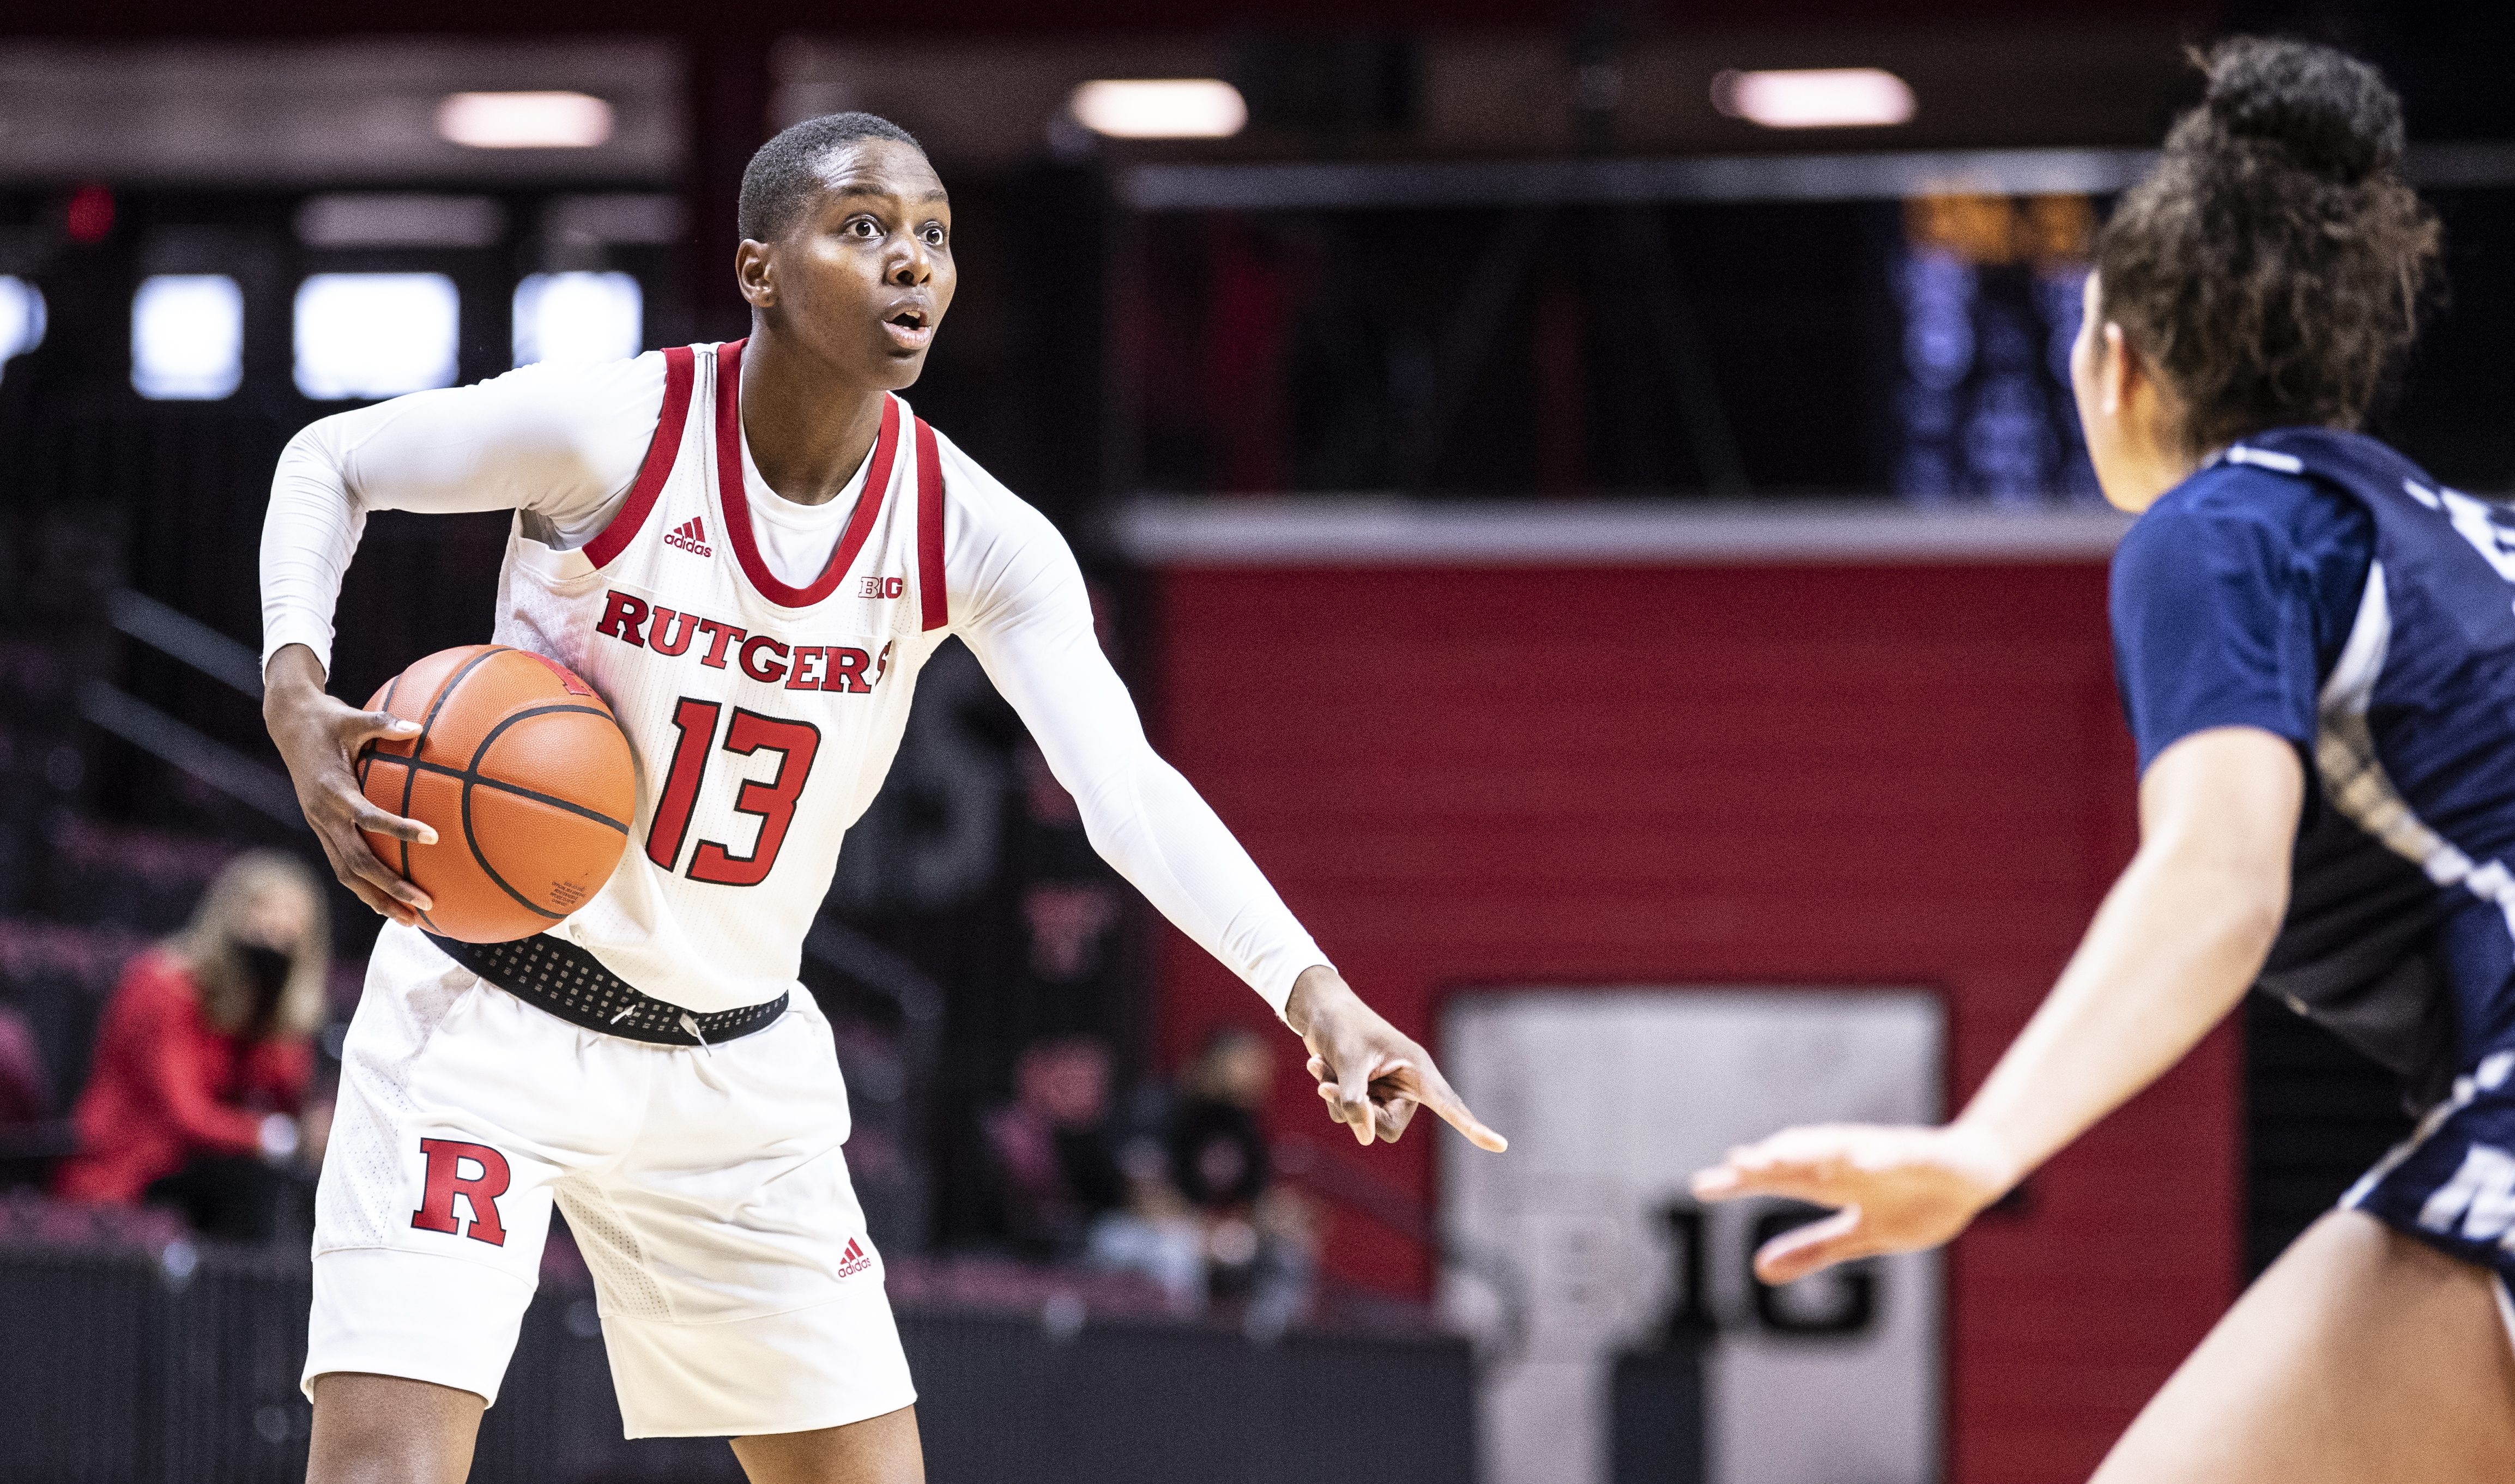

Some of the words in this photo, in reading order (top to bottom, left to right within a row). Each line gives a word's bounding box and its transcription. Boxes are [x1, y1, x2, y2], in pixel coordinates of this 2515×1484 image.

[664, 534, 712, 558] adidas
[646, 696, 821, 887] 13
[410, 1137, 511, 1248] R
[838, 1257, 871, 1277] adidas
